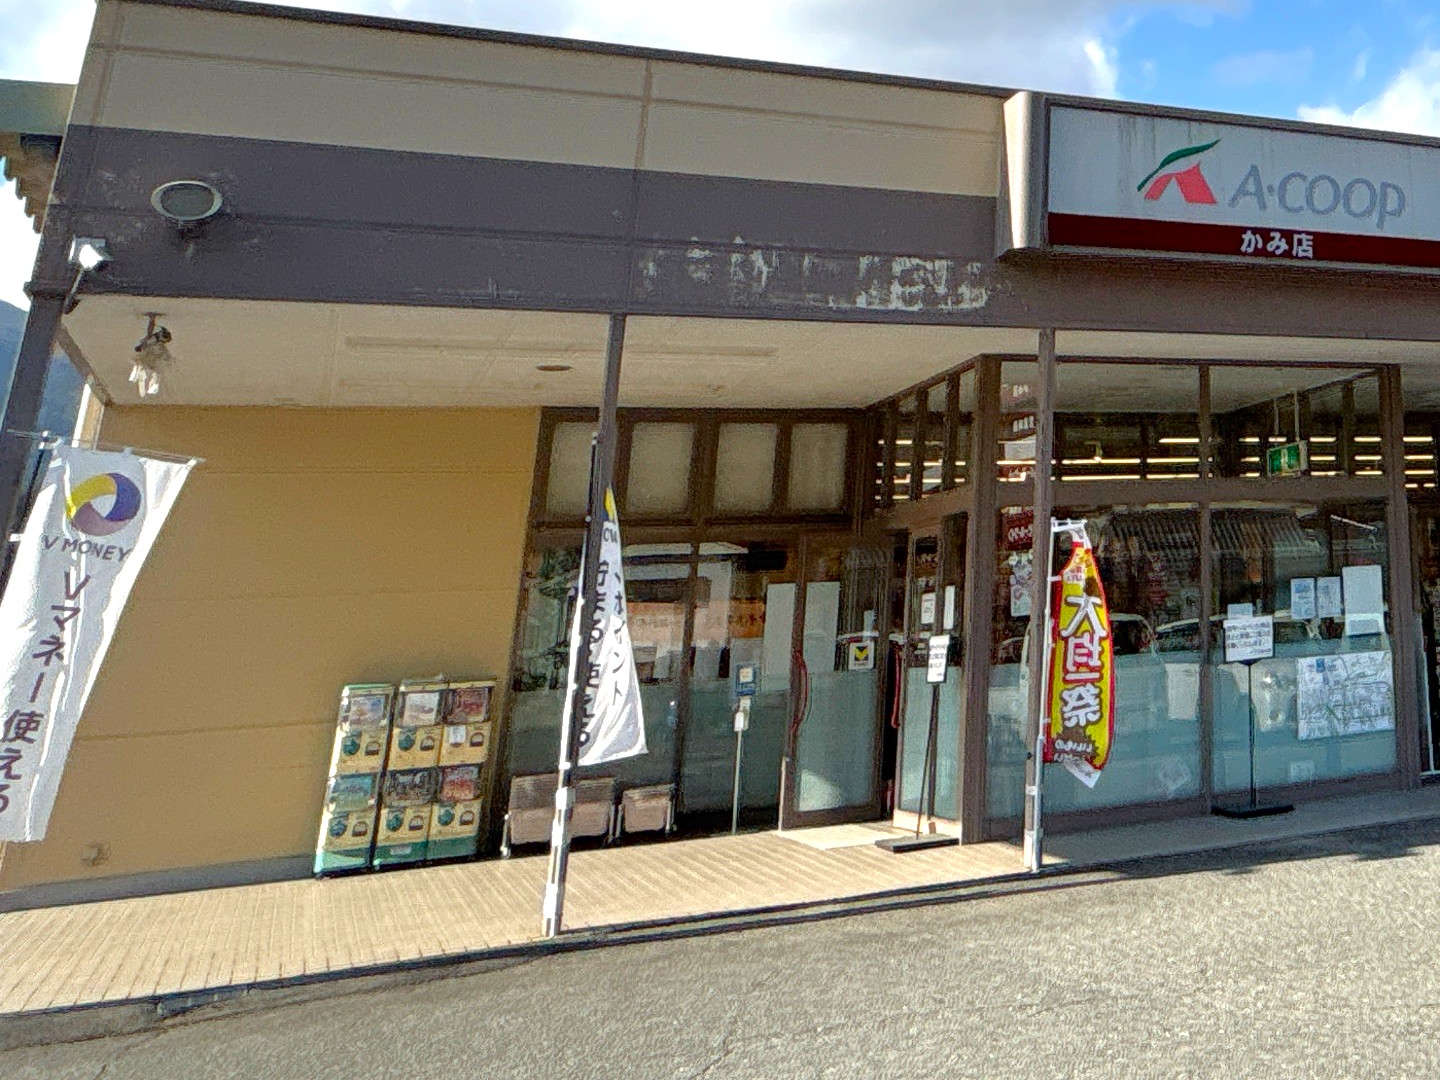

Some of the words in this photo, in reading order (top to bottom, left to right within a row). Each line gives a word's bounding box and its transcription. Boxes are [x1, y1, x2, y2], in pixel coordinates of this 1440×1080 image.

[1240, 230, 1314, 259] かみ店
[61, 537, 134, 563] MONEY
